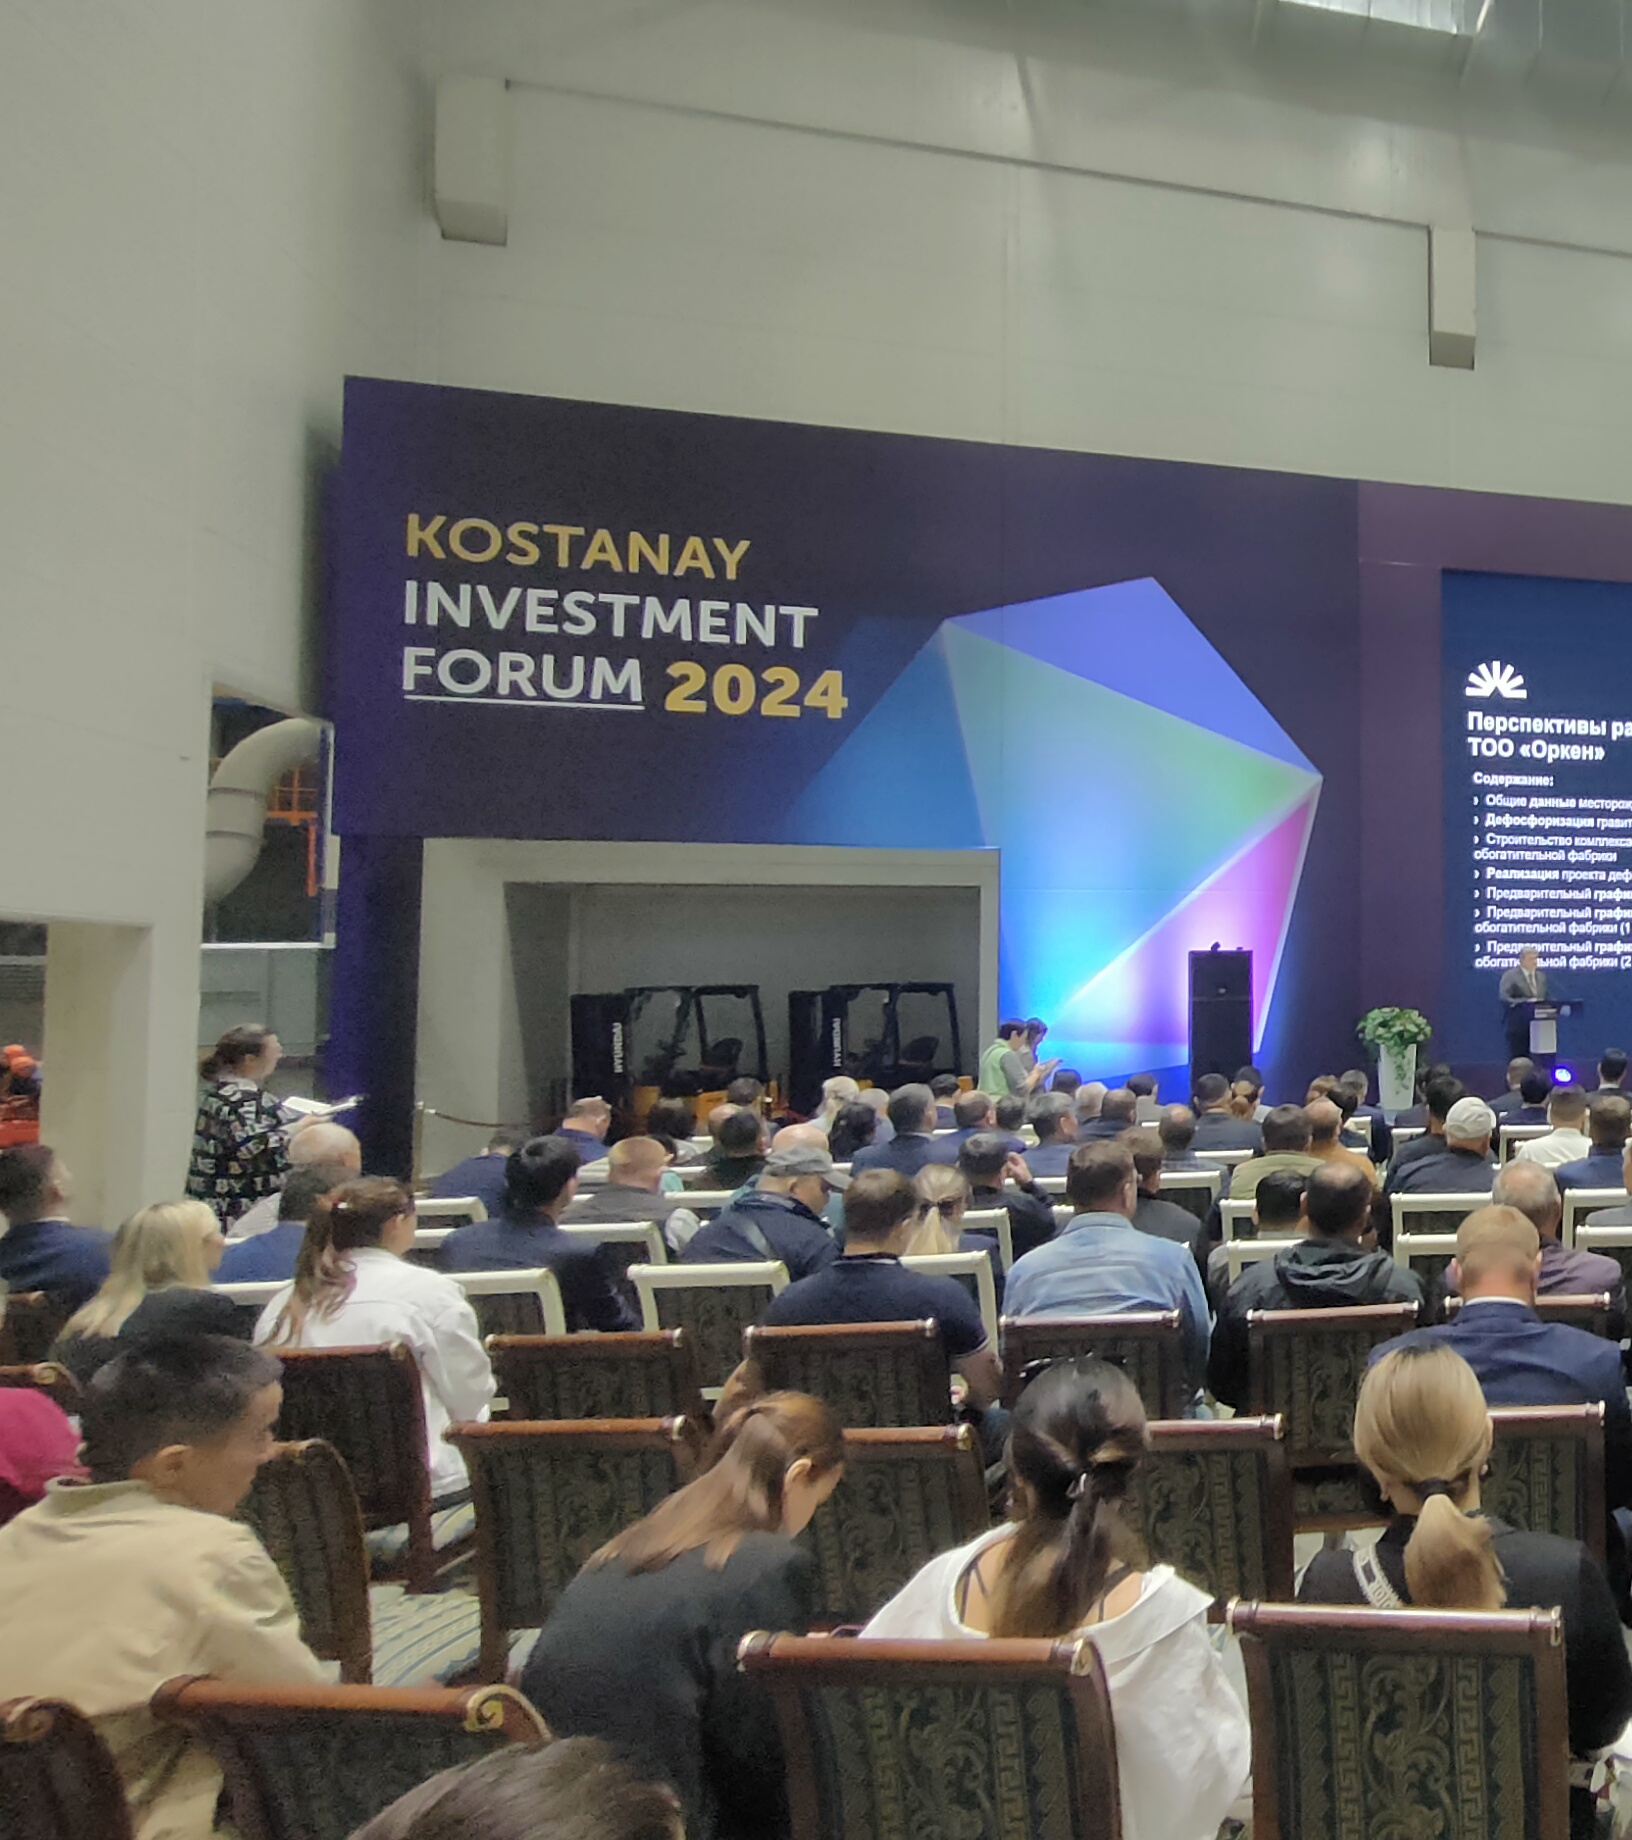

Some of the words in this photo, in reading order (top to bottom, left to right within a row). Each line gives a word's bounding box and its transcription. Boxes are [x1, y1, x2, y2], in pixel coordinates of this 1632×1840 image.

[406, 513, 751, 580] KOSTANAY
[404, 580, 818, 648] INVESTMENT
[402, 646, 643, 702] FORUM
[664, 661, 848, 719] 2024
[1468, 711, 1606, 735] Перспективы
[1468, 737, 1514, 757] ТОО
[1519, 740, 1605, 763] «Оркен»
[1473, 771, 1554, 787] Содержание:
[1485, 793, 1527, 808] Общие
[1529, 796, 1576, 809] данные
[1485, 812, 1595, 829] Дефосфоризация
[1486, 832, 1573, 848] Строительство
[1574, 835, 1632, 847] комплекса
[1474, 848, 1566, 861] обогатительной
[1567, 849, 1617, 863] фабрики
[1486, 866, 1560, 881] Реализация
[1561, 869, 1606, 882] проекта
[1486, 886, 1592, 902] Предварительный
[1486, 905, 1592, 920] Предварительный
[1474, 921, 1566, 934] обогатительной
[1568, 922, 1617, 936] фабрики
[1619, 922, 1631, 935] (1
[1568, 956, 1618, 971] фабрики
[1620, 956, 1632, 970] (2
[613, 1022, 623, 1073] HYUNDAI
[832, 1017, 841, 1067] HYUNDAI
